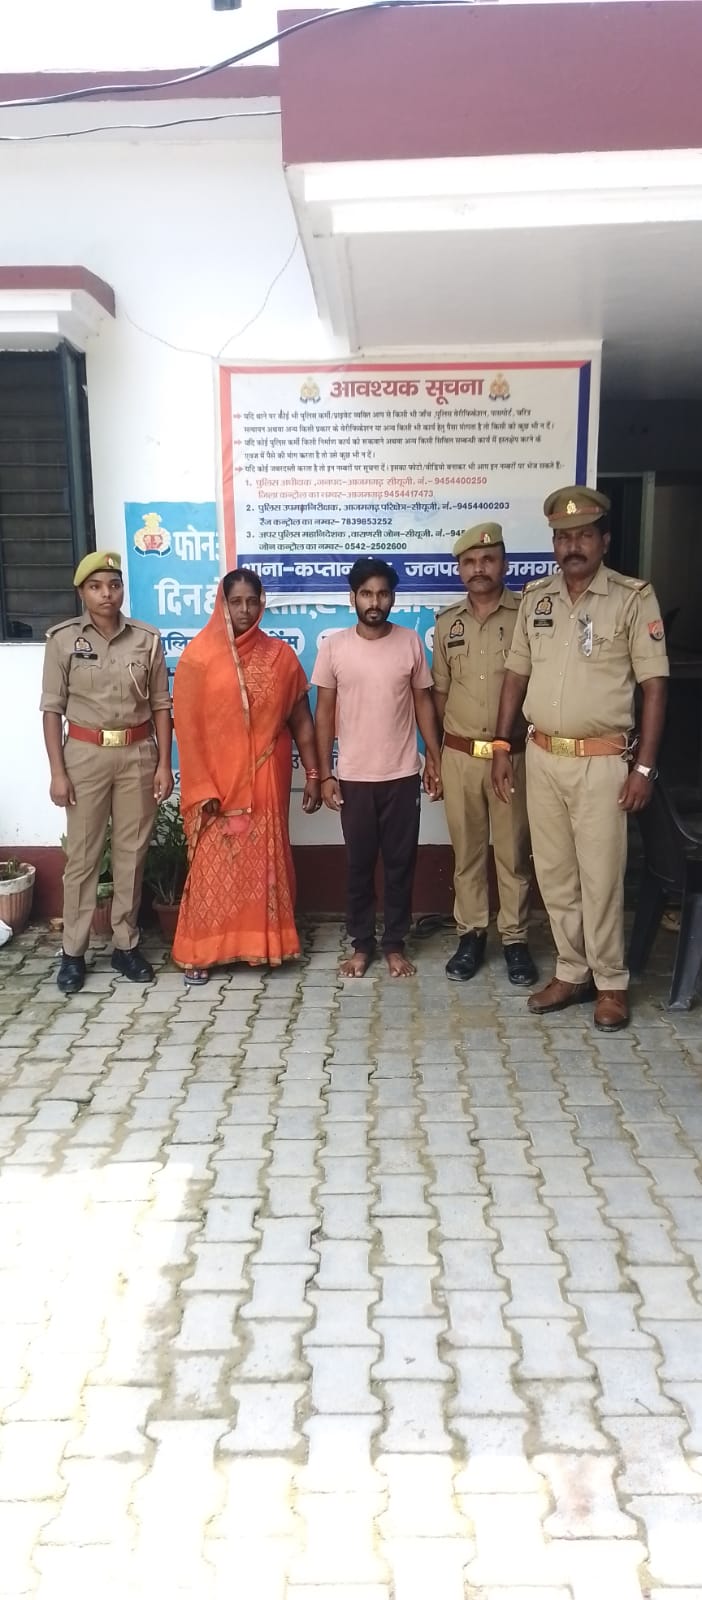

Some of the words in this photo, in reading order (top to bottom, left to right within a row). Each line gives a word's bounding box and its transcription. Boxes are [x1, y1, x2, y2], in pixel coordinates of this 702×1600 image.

[330, 379, 420, 397] आवश्यक
[425, 379, 484, 405] सूचना
[278, 409, 289, 420] कोई
[300, 411, 316, 421] पुलिस
[518, 423, 529, 432] कुछ
[270, 438, 286, 448] पुलिस
[520, 435, 534, 443] करने
[536, 435, 541, 443] के
[340, 451, 350, 460] कुछ
[363, 464, 379, 473] सूचना
[390, 462, 406, 470] इसका
[468, 462, 475, 470] भी
[478, 462, 488, 470] आप
[490, 461, 498, 470] इन
[518, 461, 524, 469] पर
[527, 461, 538, 469] भेज
[539, 461, 554, 469] सकते
[256, 478, 278, 488] पुलिस
[280, 478, 312, 486] अधीक्षक
[434, 476, 487, 484] 9454400250
[258, 490, 278, 498] जिला
[280, 490, 307, 500] कन्ट्रोल
[258, 502, 281, 514] पुलिस
[273, 517, 300, 527] कन्ट्रोल
[278, 530, 300, 540] पुलिस
[302, 529, 346, 538] महानिदेशक
[258, 542, 276, 550] जोन
[277, 542, 304, 551] कन्ट्रोल
[154, 577, 203, 616] दिन
